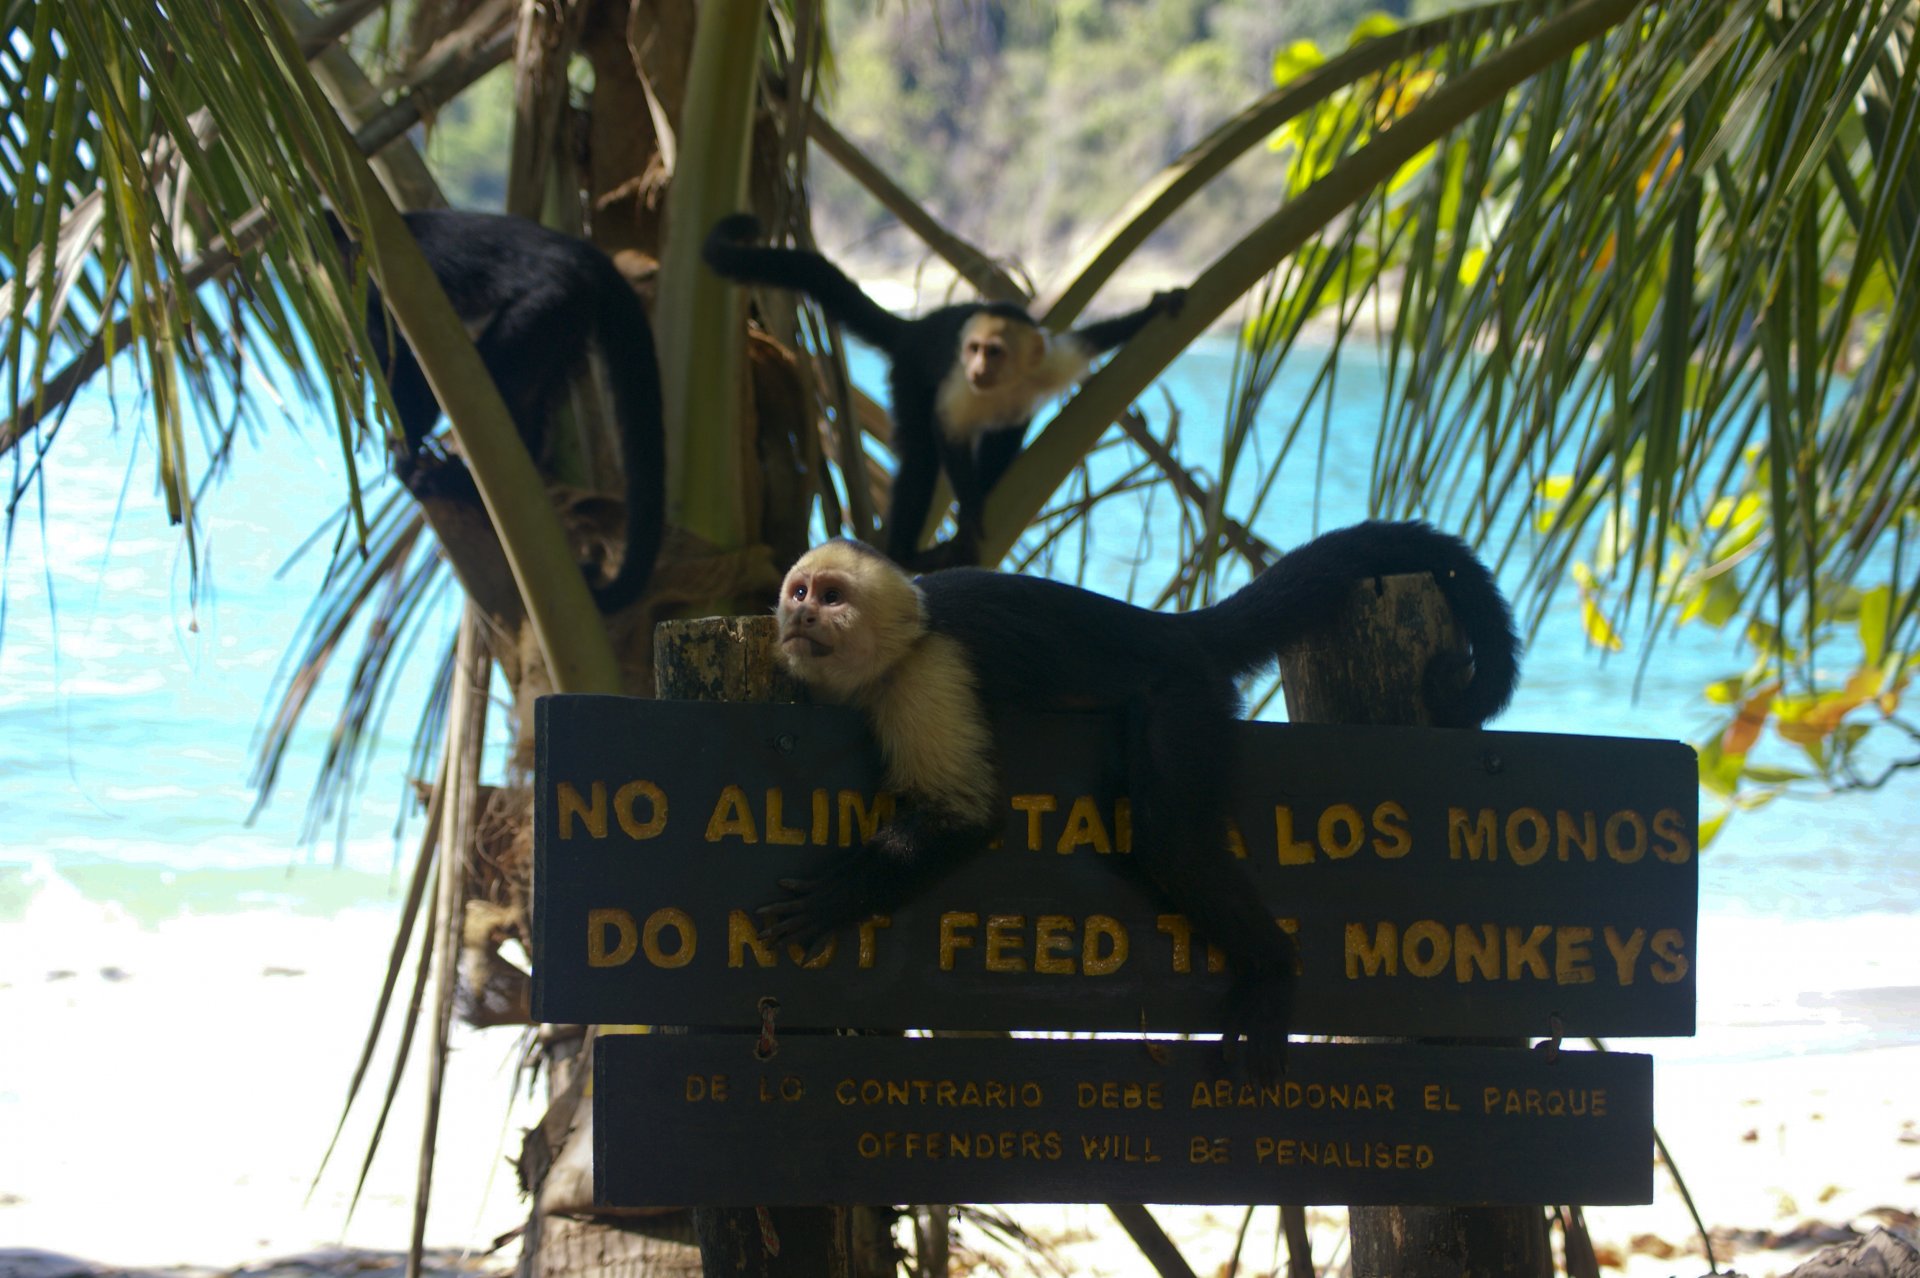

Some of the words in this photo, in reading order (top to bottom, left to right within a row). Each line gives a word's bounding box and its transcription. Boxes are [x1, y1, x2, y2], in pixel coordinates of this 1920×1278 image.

[557, 779, 668, 841] NO
[704, 785, 1133, 855] ALIMTA
[1275, 801, 1413, 866] LOS
[1447, 806, 1692, 866] MONOS
[587, 907, 697, 969] DO
[939, 911, 1130, 976] FEED
[1344, 919, 1690, 986] MONKEYS
[685, 1074, 730, 1102] DE
[759, 1075, 805, 1102] LO
[835, 1078, 1044, 1109] CONTRARIO
[1078, 1081, 1164, 1111] DEBE
[1191, 1080, 1396, 1111] ABANDONAR
[1424, 1085, 1461, 1112] EL
[1484, 1087, 1608, 1118] PARQUE
[857, 1130, 1064, 1161] OFFENDERS
[1080, 1134, 1162, 1164] WILL
[1190, 1136, 1231, 1166] BE
[1255, 1136, 1435, 1170] PENALISED
